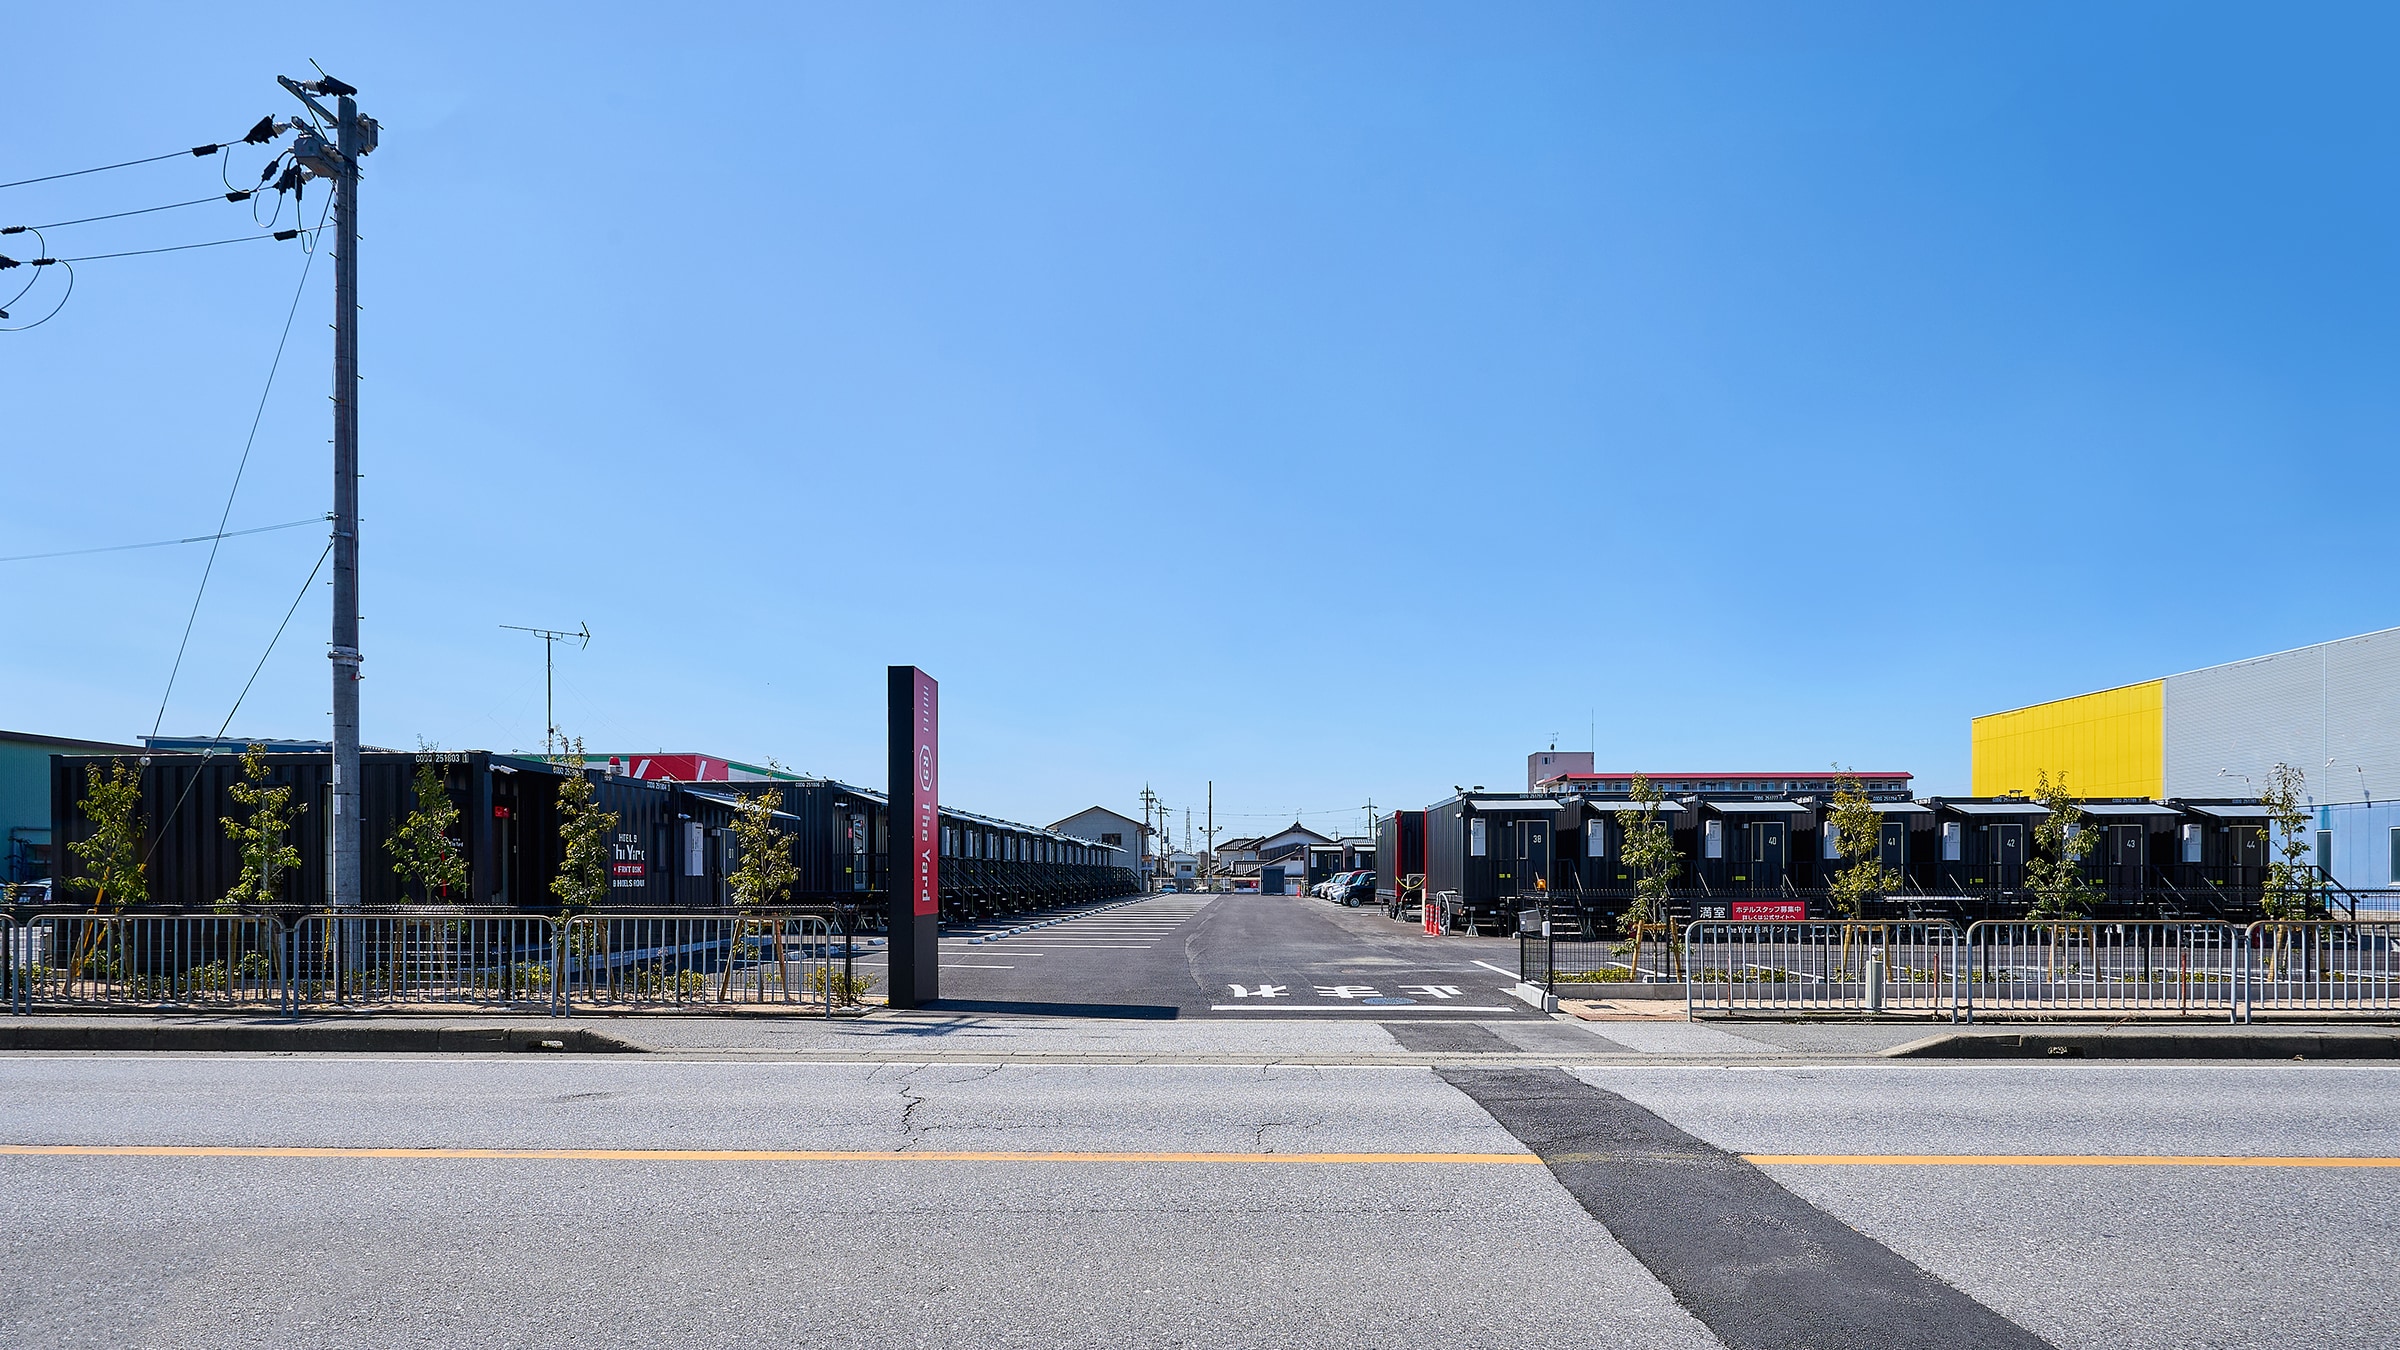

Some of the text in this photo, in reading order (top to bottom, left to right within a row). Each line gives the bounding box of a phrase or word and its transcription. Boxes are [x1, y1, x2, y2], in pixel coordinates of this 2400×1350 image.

[1533, 834, 1541, 843] 38
[1768, 836, 1777, 845] 40
[1887, 837, 1896, 846] 41
[2006, 838, 2015, 848] 42
[2126, 839, 2136, 848] 43
[2246, 840, 2255, 849] 44
[613, 844, 626, 860] he
[922, 802, 931, 901] The Yard
[1700, 906, 1726, 919] 満室
[1228, 983, 1464, 999] 止まれ
